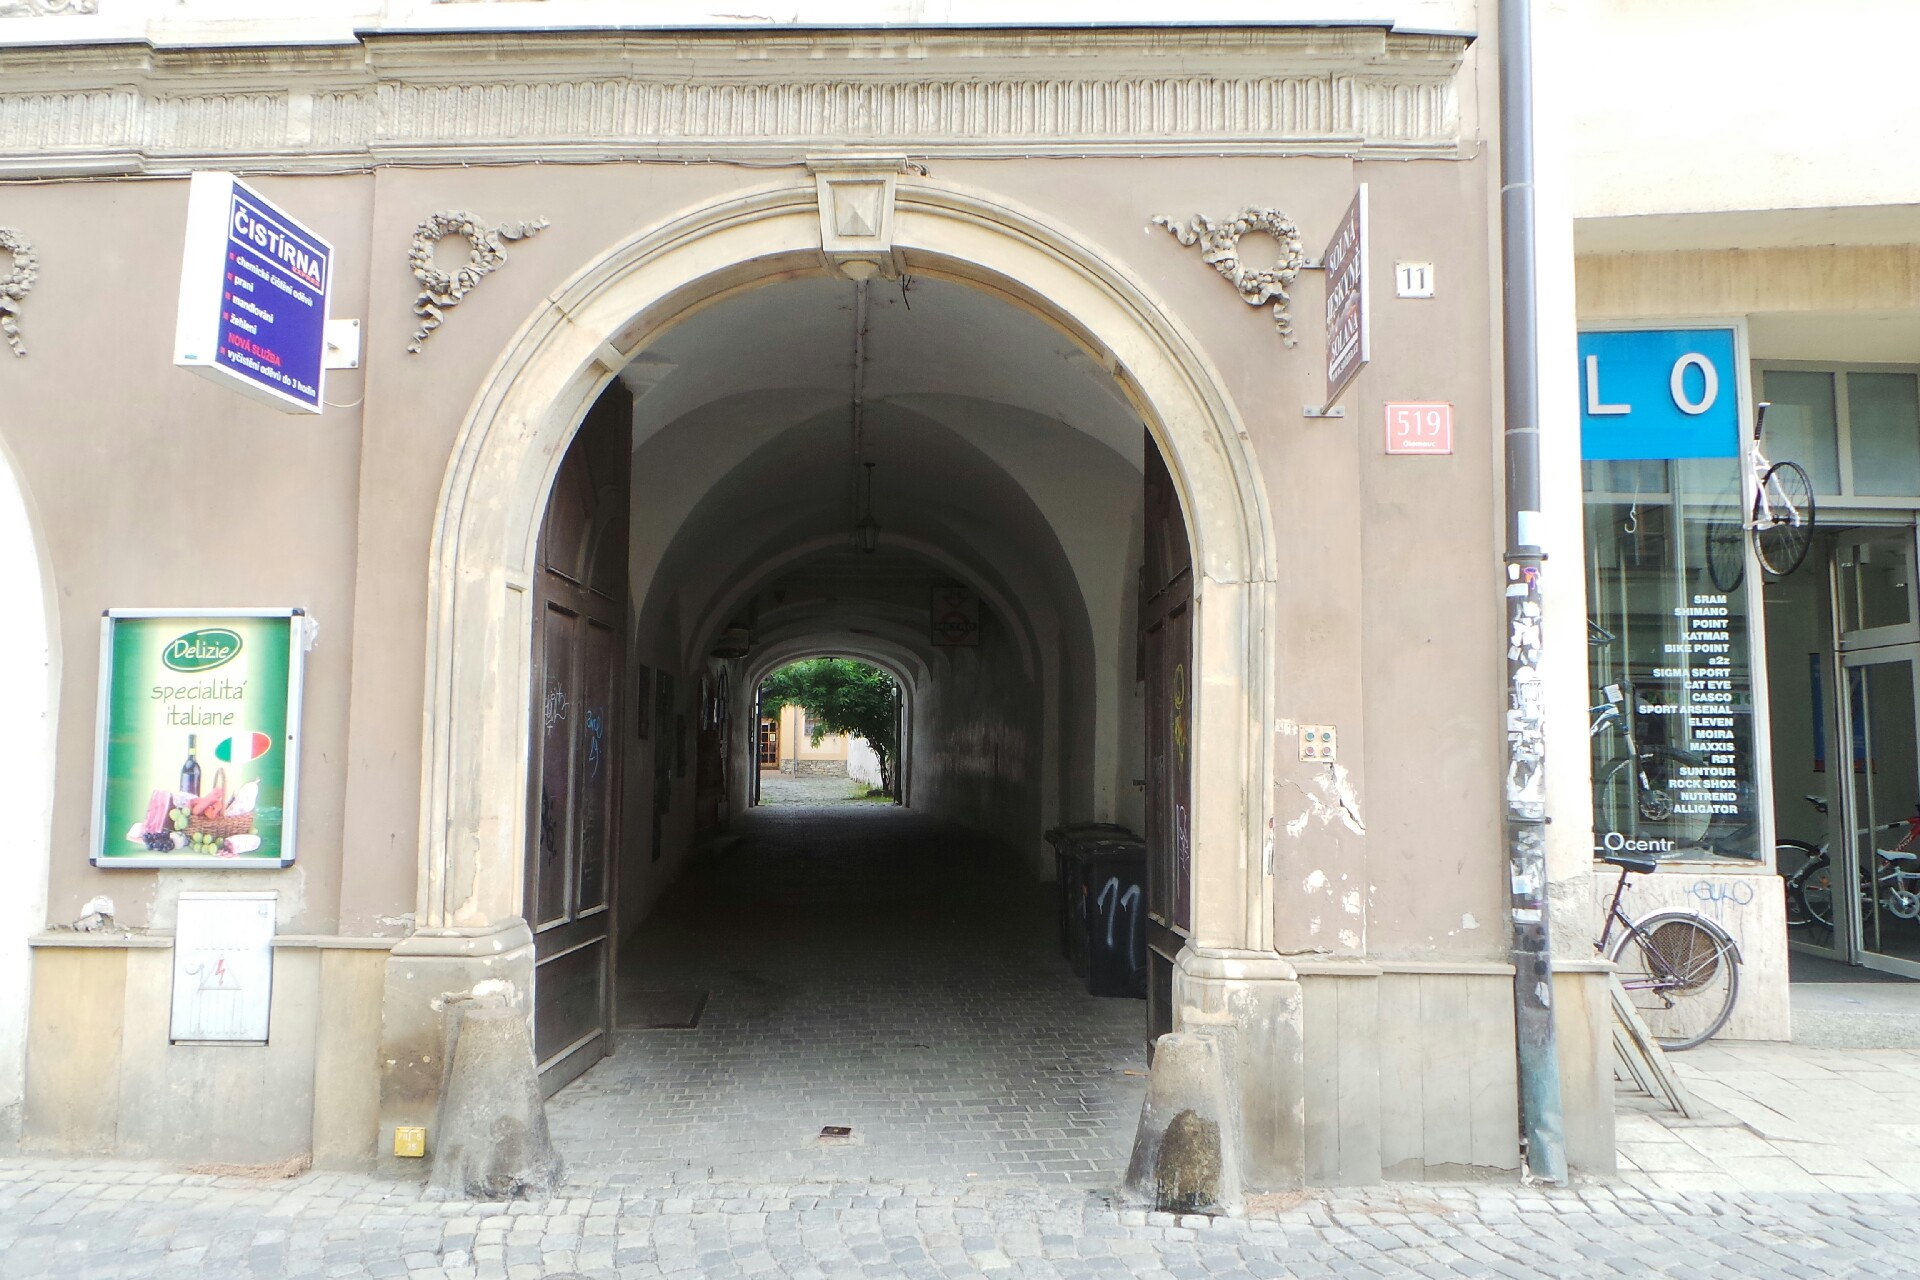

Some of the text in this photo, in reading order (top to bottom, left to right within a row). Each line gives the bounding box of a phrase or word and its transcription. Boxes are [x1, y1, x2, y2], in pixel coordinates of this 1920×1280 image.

[234, 206, 321, 281] ČISTÍRNA
[1329, 210, 1356, 279] SOLNÁ
[236, 255, 313, 307] chemické čištění oděvů
[1402, 267, 1426, 290] 11
[234, 276, 254, 293] praní
[1327, 248, 1361, 324] JESKYNĚ
[232, 294, 274, 324] mandlování
[230, 313, 257, 335] žehlení
[1331, 313, 1358, 360] SOLANA
[228, 332, 282, 367] NOVÁ SLUŽBA
[260, 365, 282, 382] oděvů
[282, 374, 292, 386] do
[292, 378, 298, 388] 3
[297, 380, 316, 398] hodin
[1397, 410, 1441, 437] 519
[1403, 440, 1436, 448] Olomouc
[1694, 595, 1727, 604] SRAM
[1674, 607, 1728, 616] SHIMANO
[1693, 620, 1728, 629] POINT
[1682, 632, 1729, 641] KATMAR
[174, 638, 230, 660] Delizie
[1664, 644, 1730, 653] BIKE POINT
[1709, 656, 1730, 665] a2z
[1653, 668, 1730, 677] SIGMA SPORT
[1684, 681, 1731, 690] CAT EYE
[1692, 693, 1732, 702] CASCO
[1639, 705, 1733, 714] SPORT ARSENAL
[166, 704, 234, 726] italiane
[1688, 717, 1733, 727] ELEVEN
[1695, 730, 1734, 739] MOIRA
[1690, 742, 1735, 751] MAXXIS
[1711, 754, 1735, 764] RST
[1679, 767, 1736, 777] SUNTOUR
[1668, 779, 1736, 789] ROCK SHOX
[1681, 792, 1737, 801] NUTREND
[1674, 804, 1738, 814] ALLIGATOR
[1594, 832, 1675, 851] Ocentr
